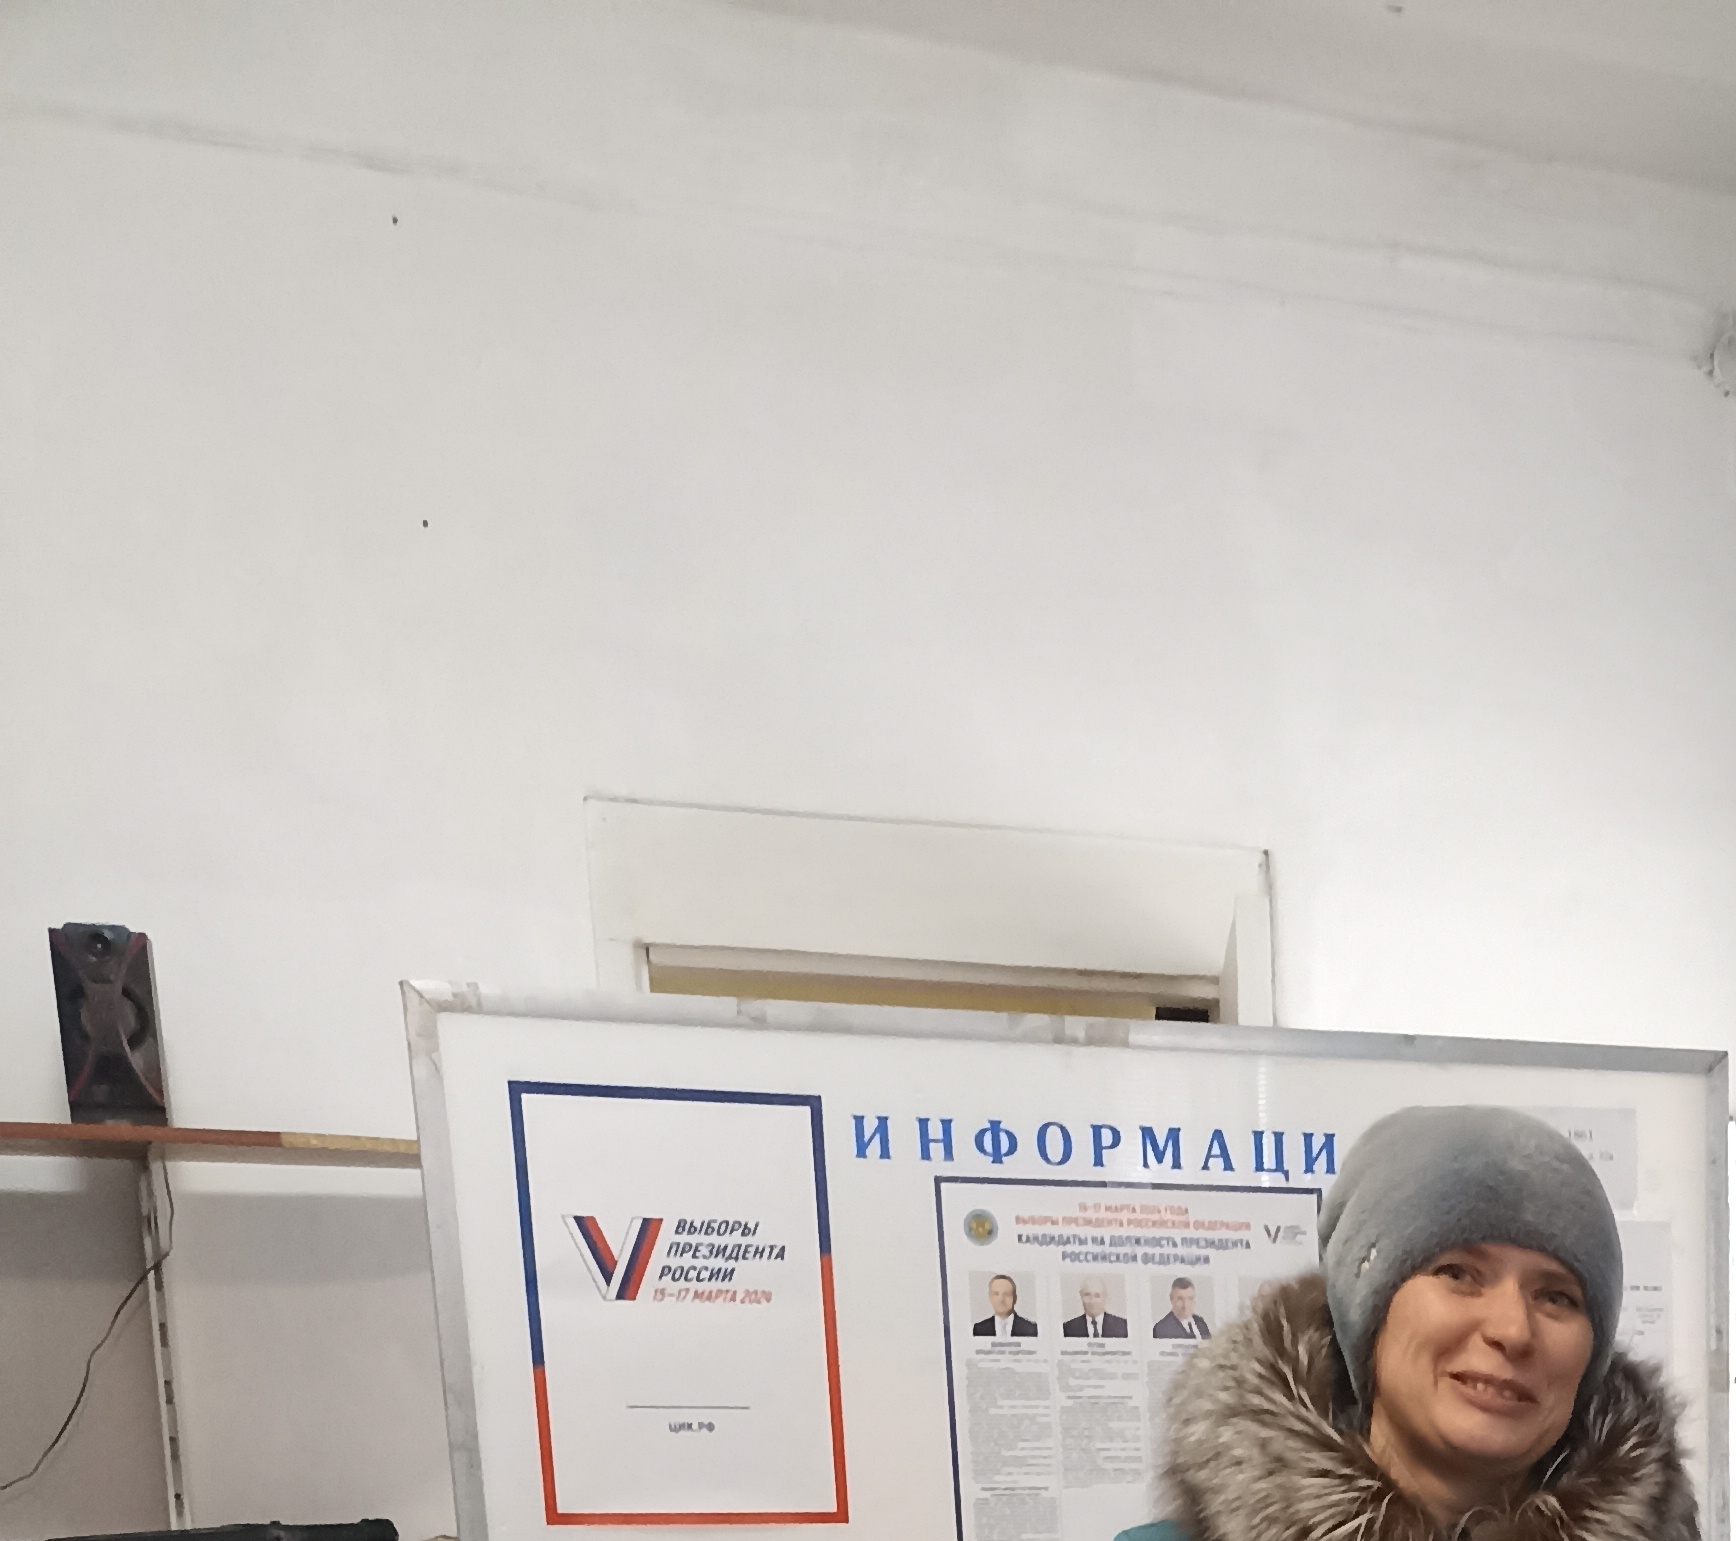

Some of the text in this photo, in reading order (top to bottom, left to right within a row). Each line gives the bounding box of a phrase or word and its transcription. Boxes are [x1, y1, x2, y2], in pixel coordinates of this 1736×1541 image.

[852, 1114, 1337, 1182] ИНФОРМАЦИ
[674, 1218, 760, 1237] ВЫБОРЫ
[666, 1241, 786, 1263] ПРЕЗИДЕНТА
[658, 1265, 736, 1283] РОССИИ
[691, 1288, 738, 1304] МАРТА
[739, 1288, 773, 1305] 2024
